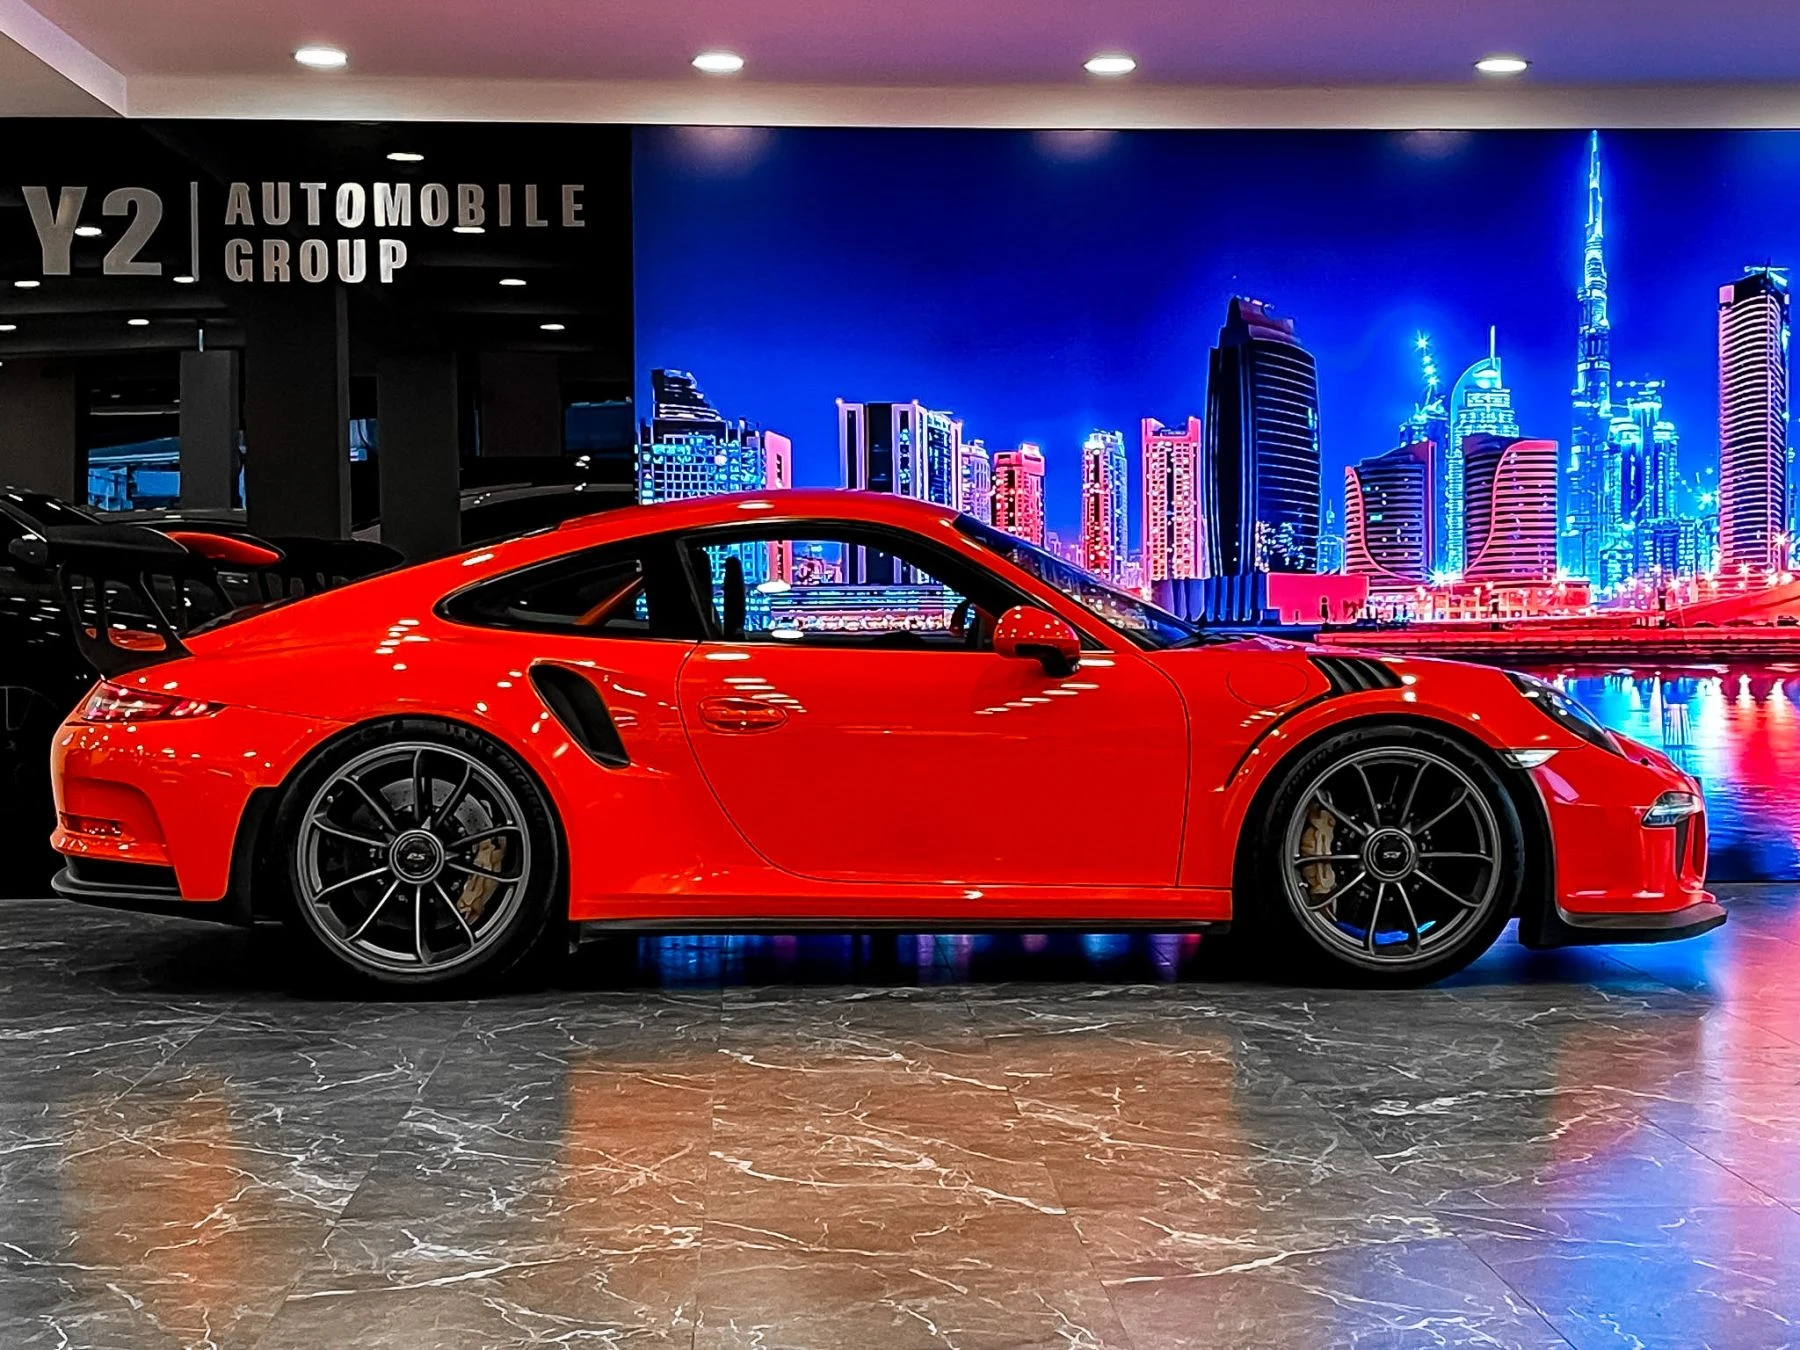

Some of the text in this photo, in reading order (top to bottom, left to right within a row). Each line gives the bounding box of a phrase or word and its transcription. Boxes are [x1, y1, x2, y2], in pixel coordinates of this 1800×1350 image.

[224, 182, 585, 227] AUTOMOBILE
[22, 186, 163, 275] Y2
[224, 239, 407, 283] GROUP
